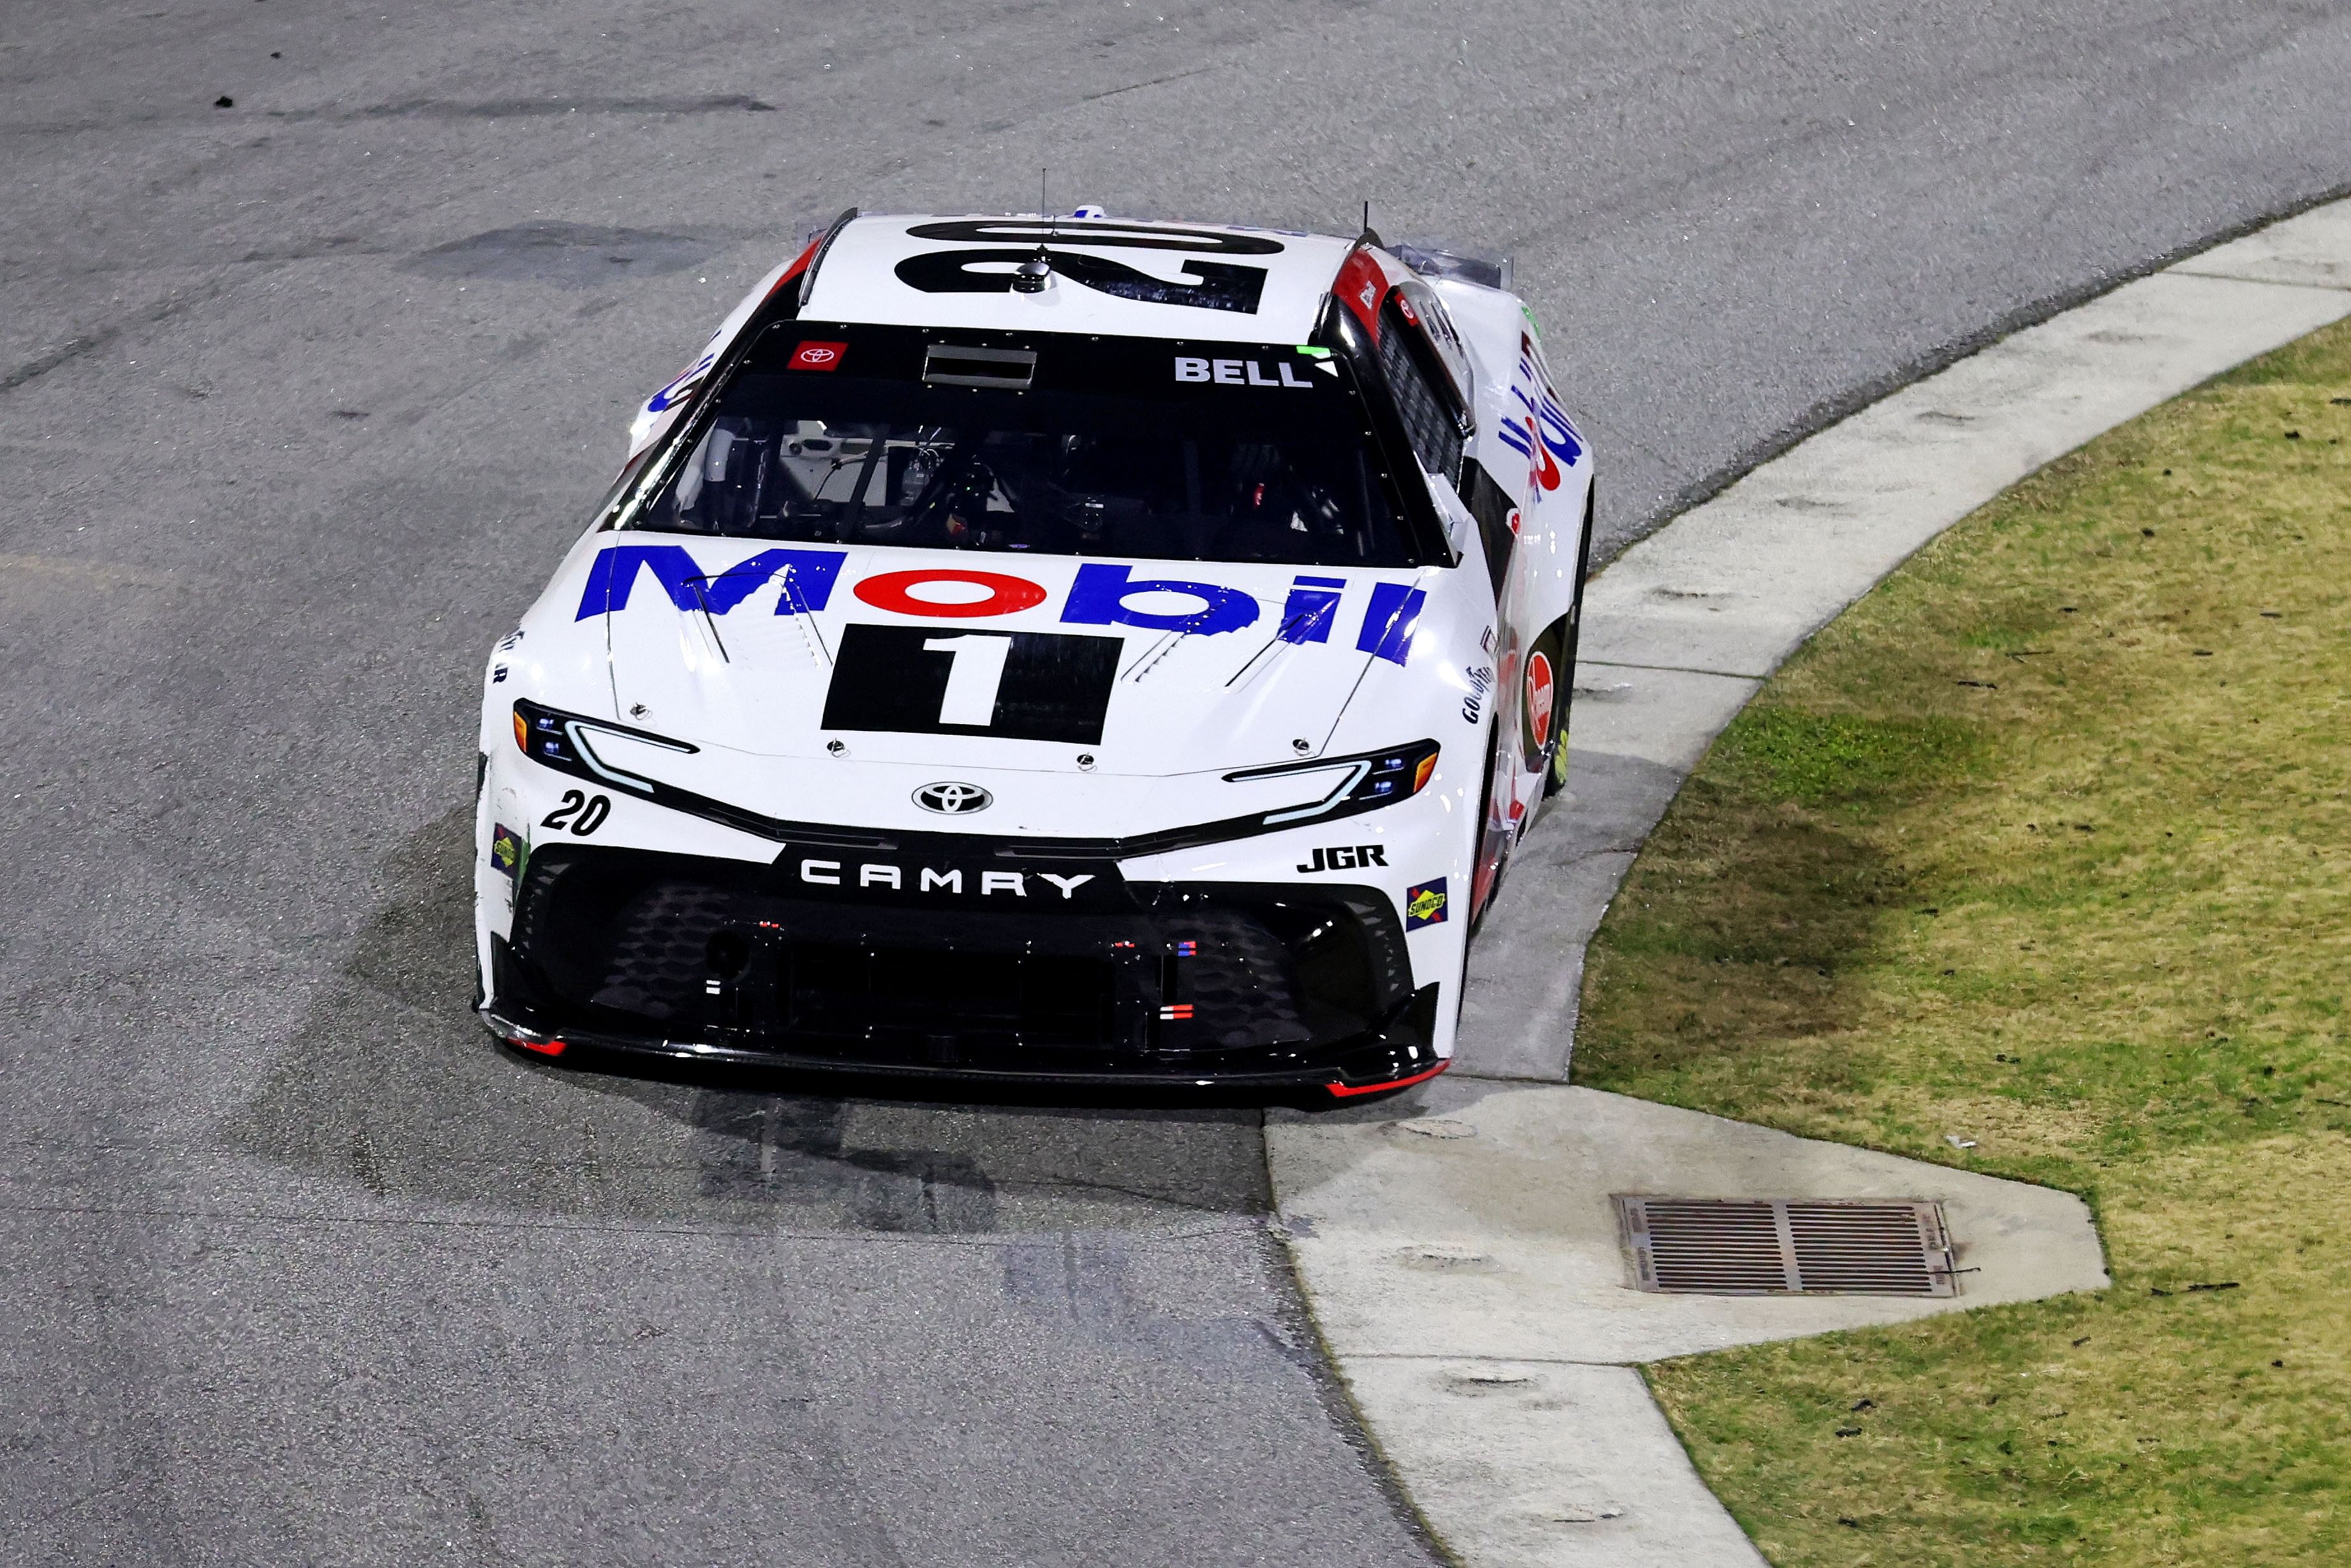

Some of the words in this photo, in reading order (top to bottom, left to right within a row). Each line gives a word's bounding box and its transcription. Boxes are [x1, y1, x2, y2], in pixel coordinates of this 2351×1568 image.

[1175, 357, 1313, 388] BELL
[574, 545, 1428, 667] Mobil
[923, 633, 1012, 727] 1
[540, 789, 611, 836] 20
[800, 859, 1096, 899] CAMRY
[1296, 844, 1389, 874] JGR
[1409, 894, 1444, 916] SUNOCO
